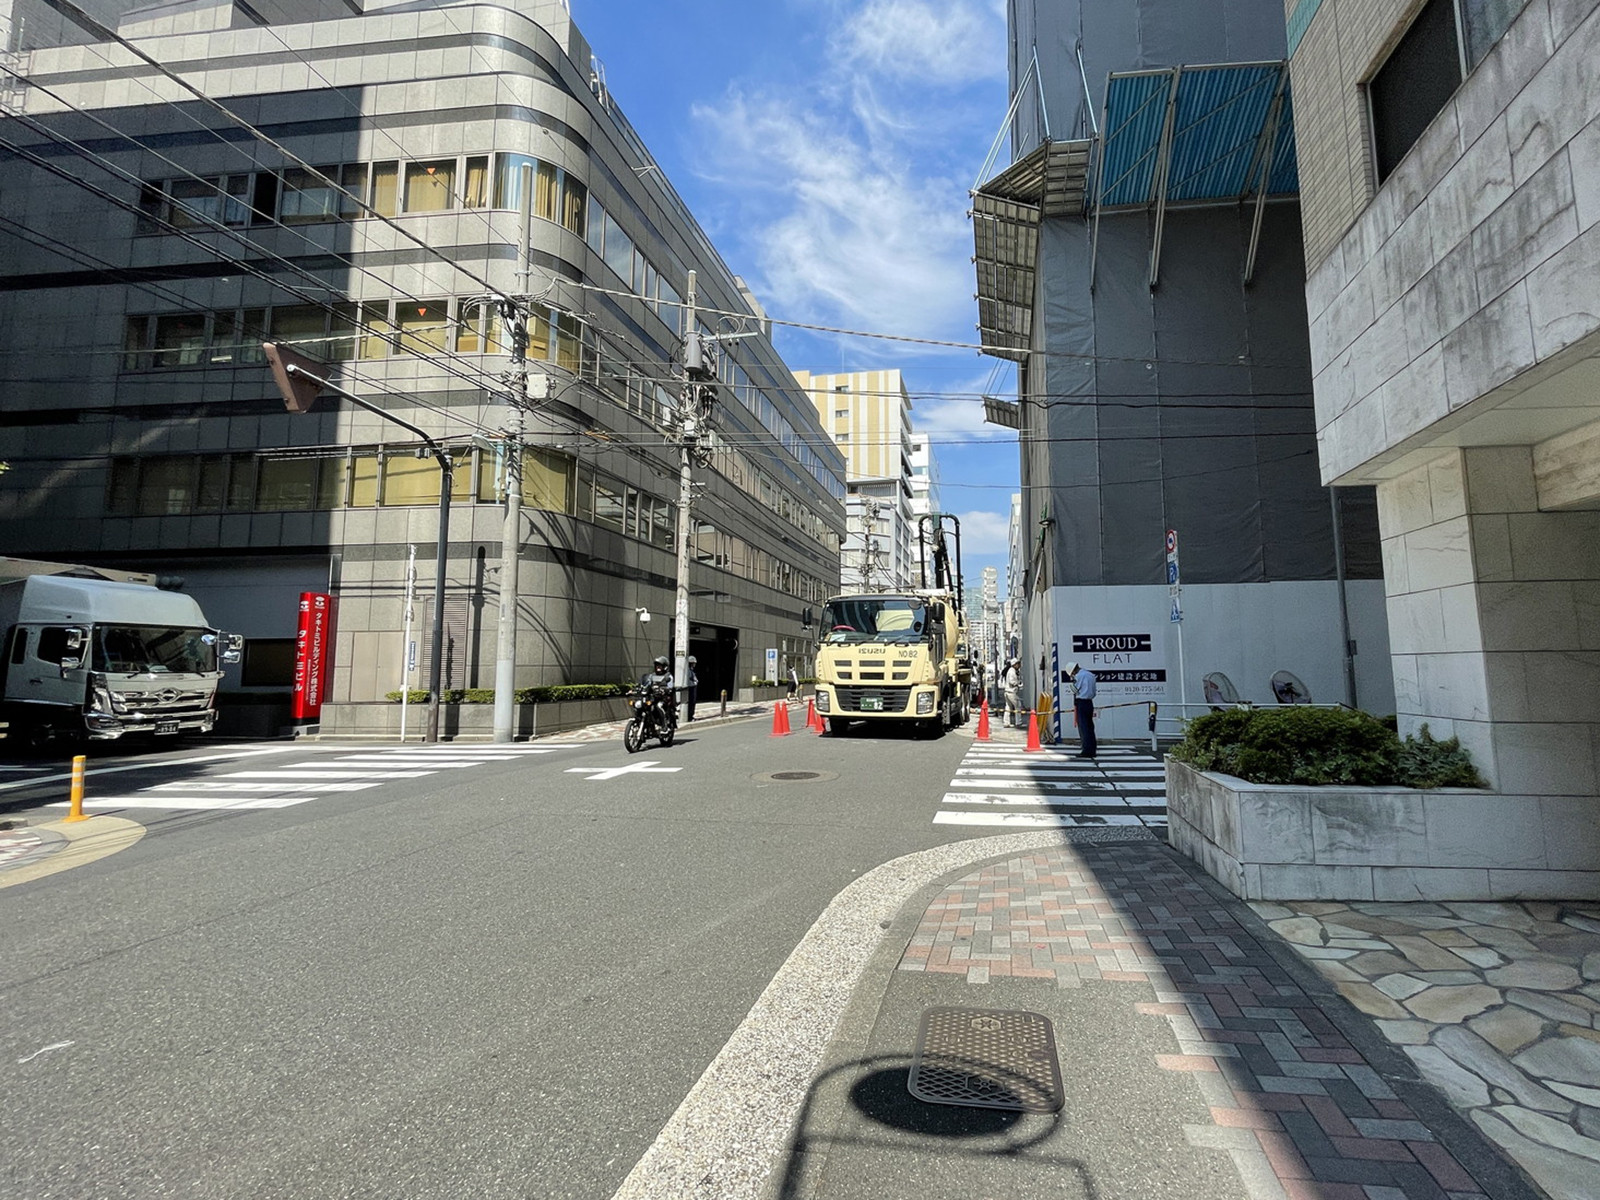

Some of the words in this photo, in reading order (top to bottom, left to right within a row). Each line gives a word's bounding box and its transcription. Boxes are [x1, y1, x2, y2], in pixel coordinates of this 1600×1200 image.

[1087, 637, 1138, 650] PROUD
[294, 629, 308, 692] タキトミビル
[1092, 653, 1132, 664] FLAT
